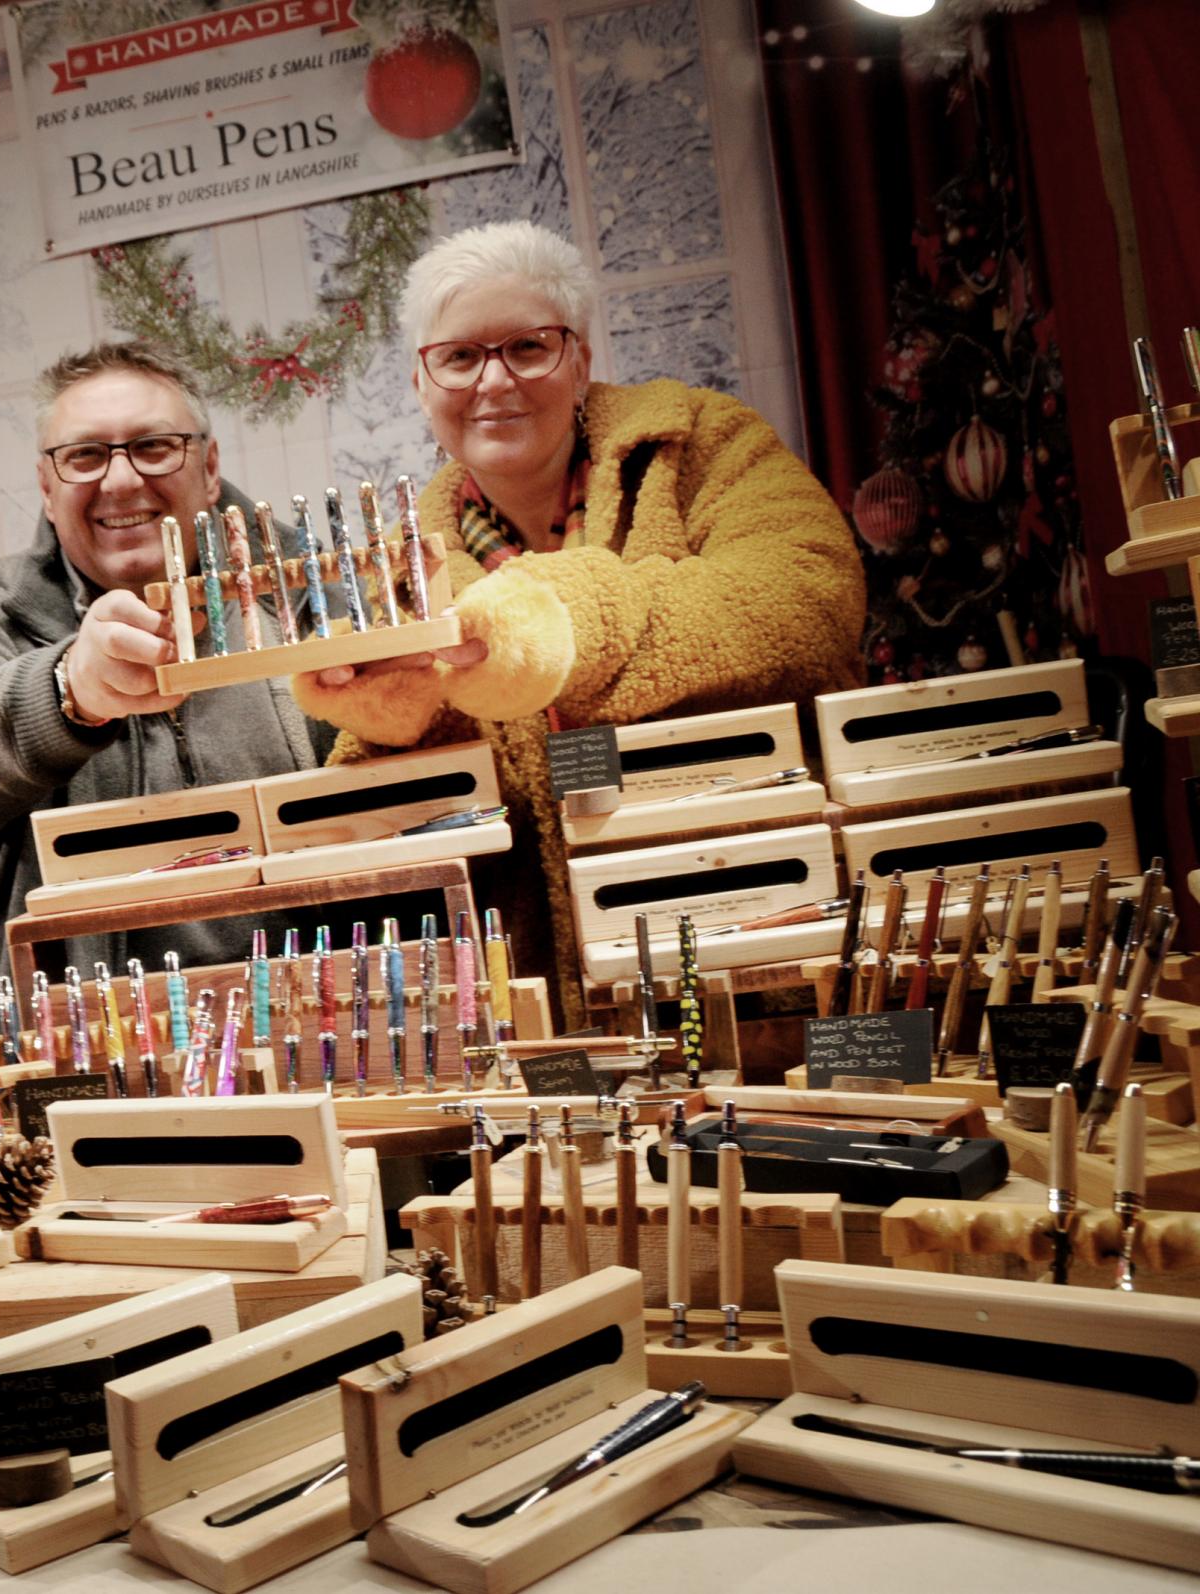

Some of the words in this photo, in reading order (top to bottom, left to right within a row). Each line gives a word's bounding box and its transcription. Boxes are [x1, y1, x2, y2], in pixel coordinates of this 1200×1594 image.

[95, 3, 304, 66] HANDMADE
[36, 109, 67, 130] PENS
[71, 106, 80, 121] &
[85, 94, 137, 118] RAZORS,
[143, 81, 200, 106] SHAVING
[205, 68, 264, 93] BRUSHES
[268, 64, 278, 79] &
[282, 53, 324, 76] SMALL
[329, 42, 371, 65] ITEMS
[66, 144, 197, 197] Beau
[215, 113, 338, 168] Pens
[78, 195, 152, 225] HANDMADE
[157, 191, 172, 209] BY
[177, 176, 250, 205] OURSELVES
[255, 172, 271, 189] IN
[276, 152, 360, 184] LANCASHIRE
[809, 1048, 840, 1058] AND
[845, 1044, 873, 1056] PEN
[877, 1044, 906, 1054] SET
[811, 1033, 846, 1044] WOOD
[853, 1030, 901, 1042] PENCIL
[828, 1059, 861, 1068] WOOD
[867, 1057, 901, 1068] BOX
